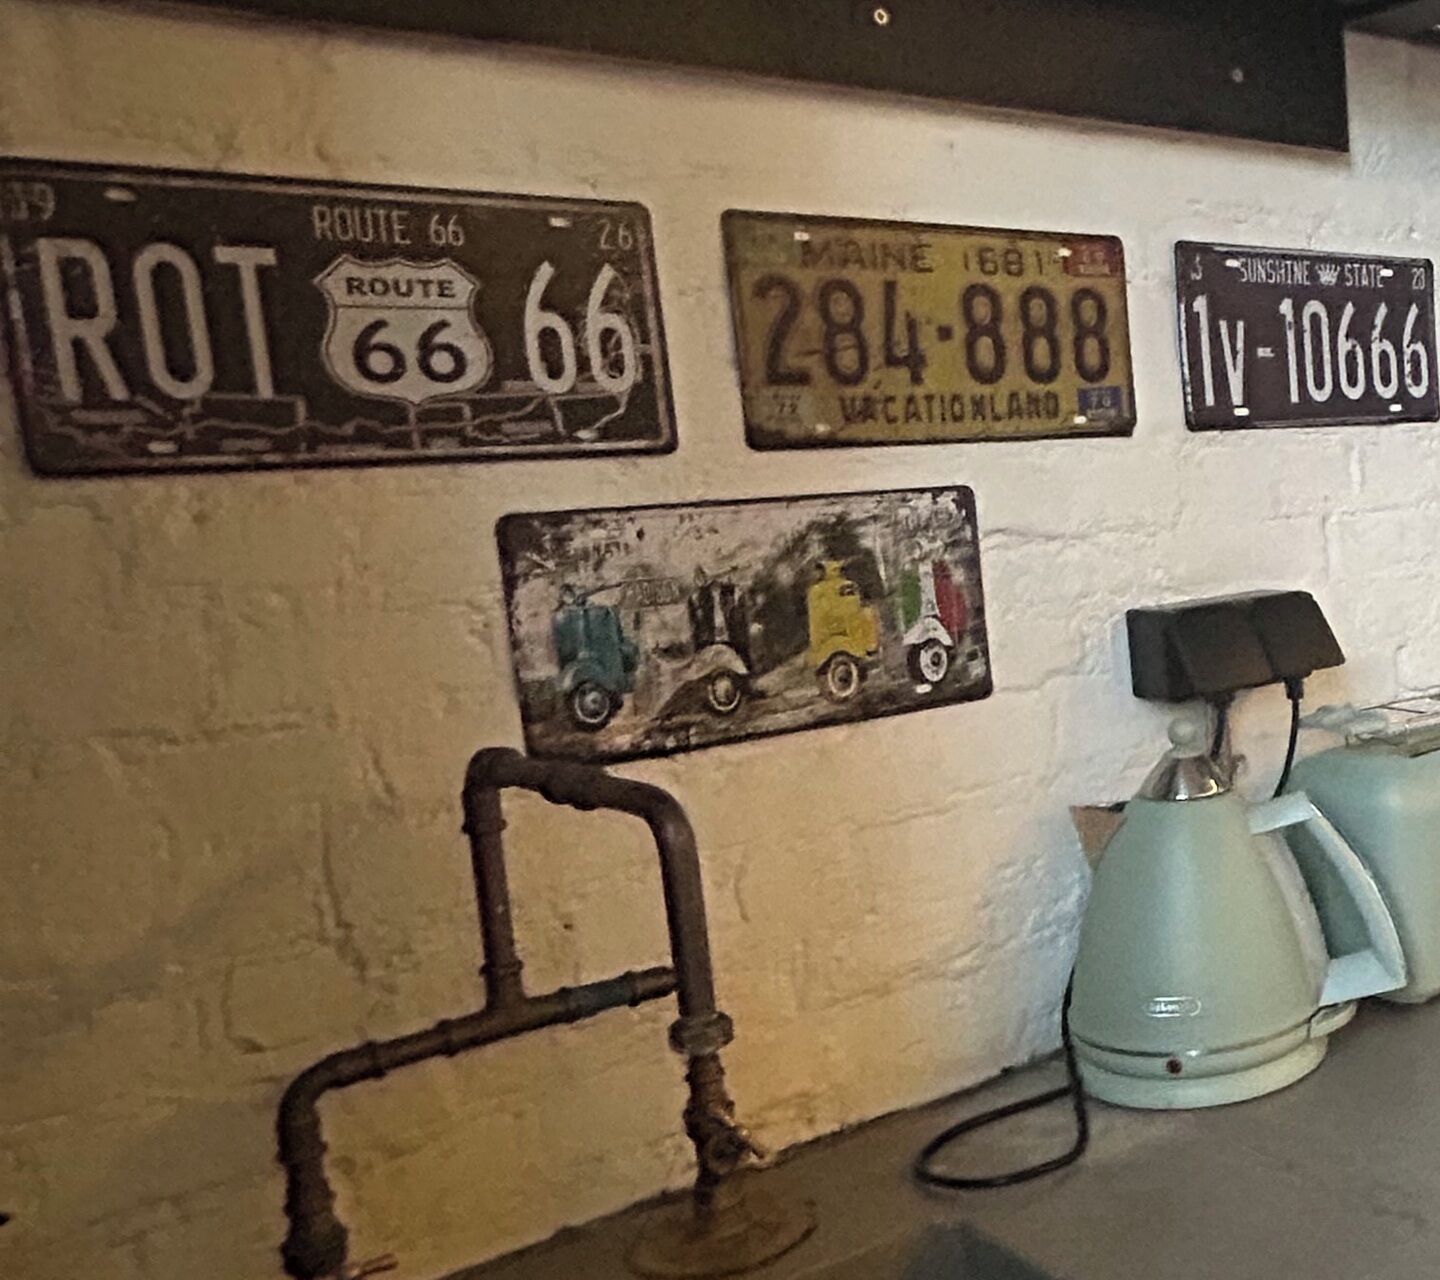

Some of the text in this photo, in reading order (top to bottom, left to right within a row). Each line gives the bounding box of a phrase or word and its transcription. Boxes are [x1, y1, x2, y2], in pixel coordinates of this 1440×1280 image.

[312, 205, 465, 248] ROUTE 66
[598, 218, 633, 251] 26
[800, 238, 935, 273] MAINE
[1237, 257, 1386, 289] SUNSHINE STATE
[345, 276, 457, 299] ROUTE
[34, 235, 637, 403] ROT 66
[353, 319, 468, 384] 66
[838, 390, 1061, 426] VACATIONLAND
